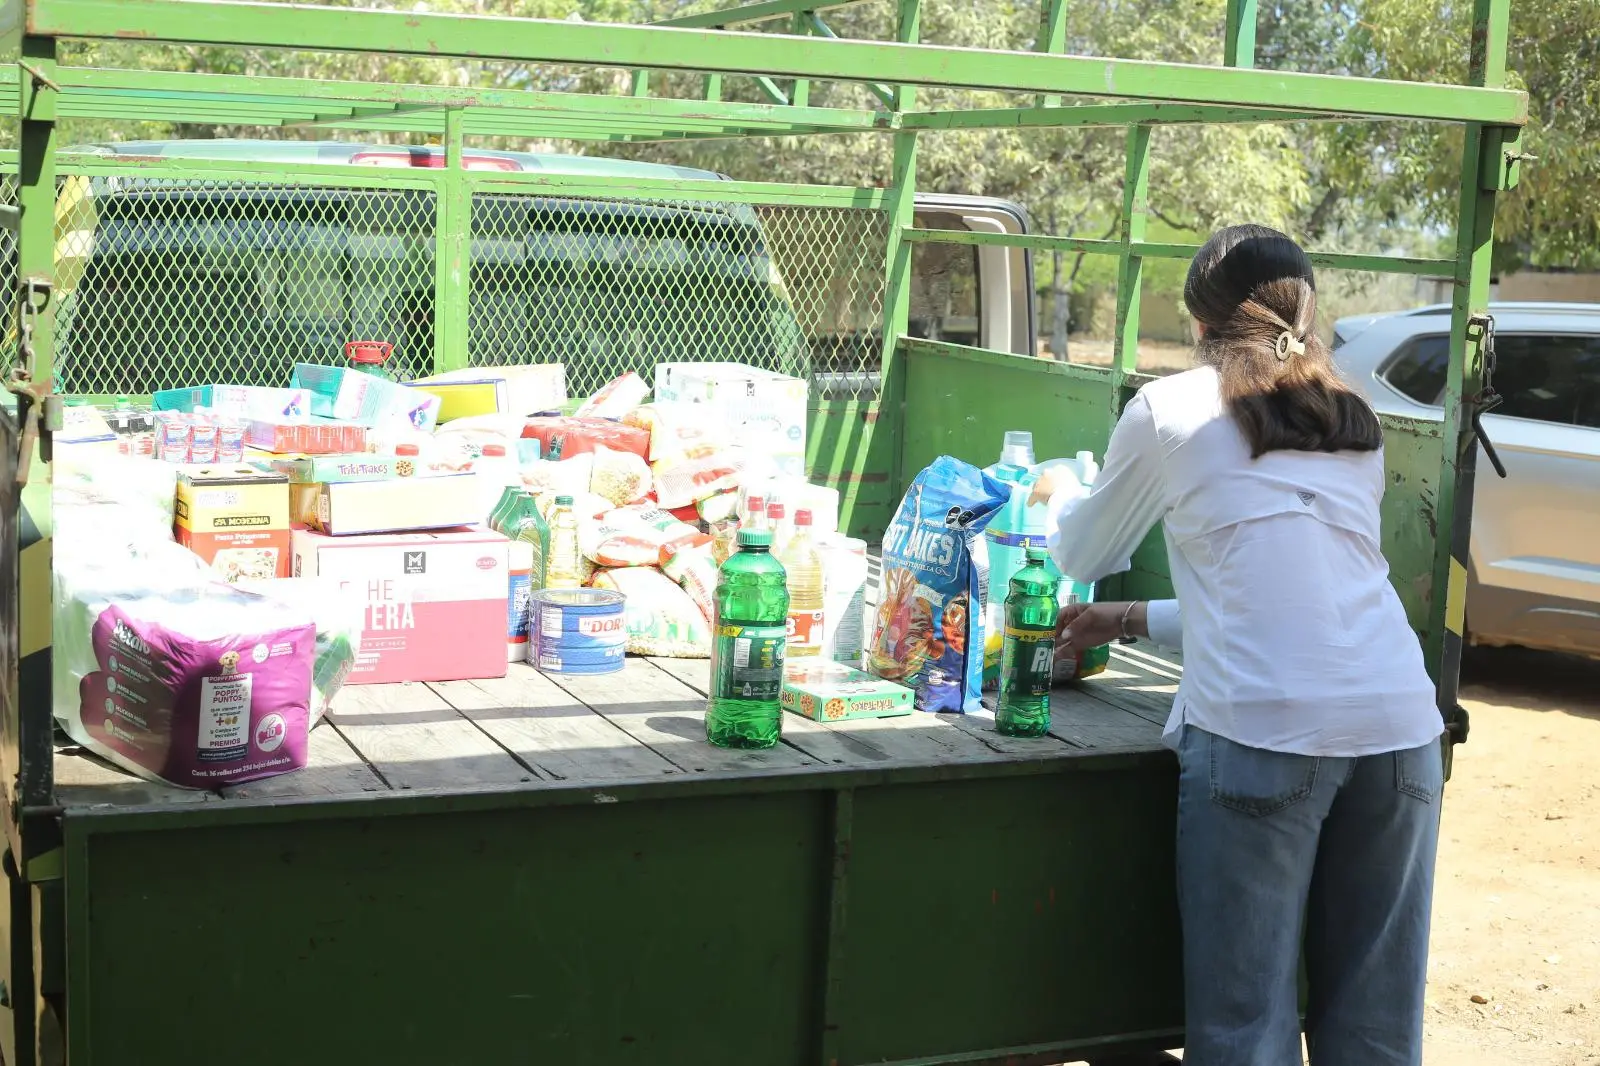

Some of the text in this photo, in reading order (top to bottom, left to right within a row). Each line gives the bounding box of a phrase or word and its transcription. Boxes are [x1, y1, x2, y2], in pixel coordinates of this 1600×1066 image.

[337, 463, 389, 476] Triki-Trakes
[228, 516, 269, 526] MODERNA
[215, 689, 239, 697] POPPY
[213, 694, 242, 703] PUNTOS
[850, 698, 894, 712] Triki-Trakes
[210, 738, 241, 747] PREMIOS
